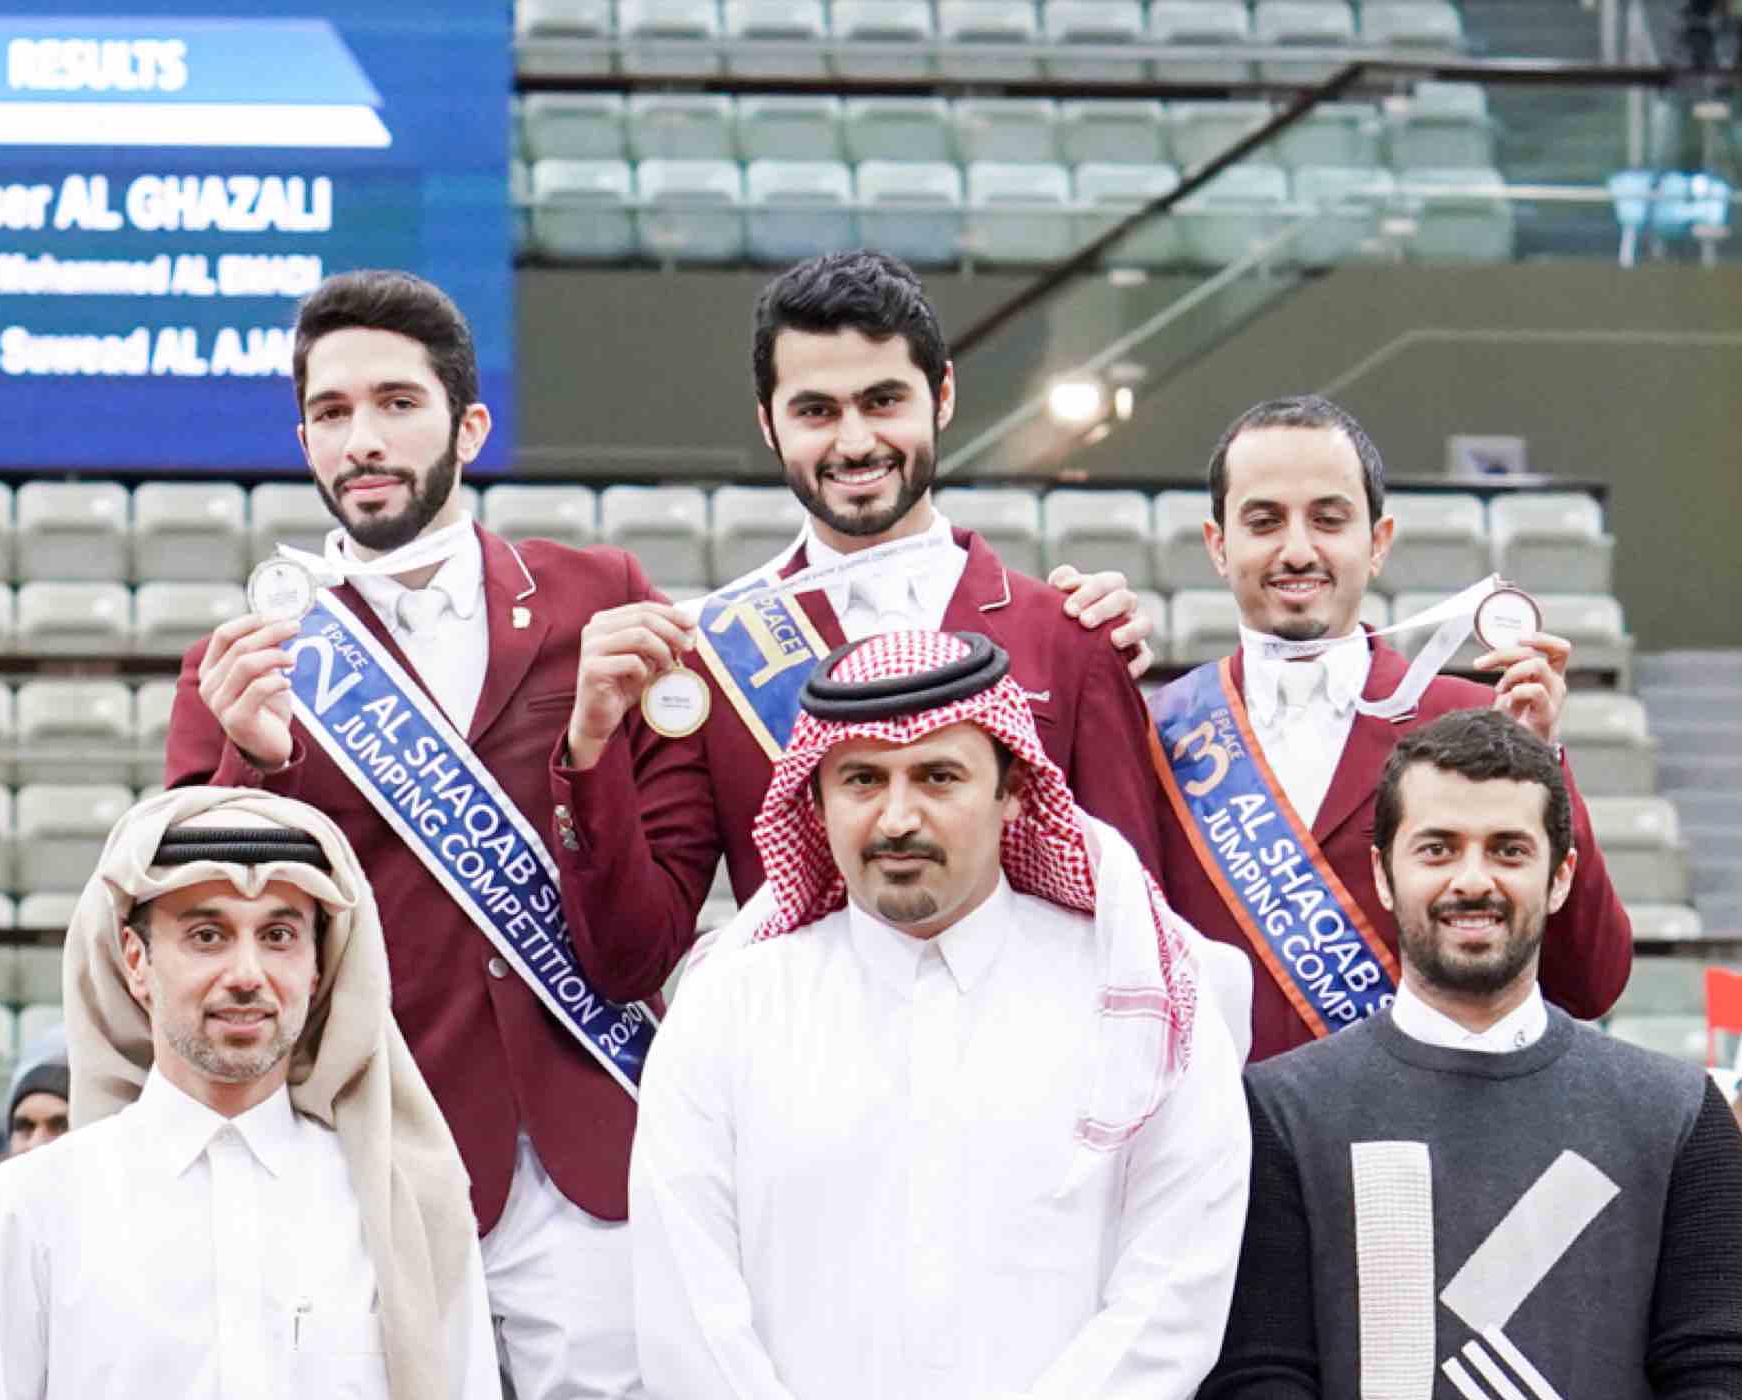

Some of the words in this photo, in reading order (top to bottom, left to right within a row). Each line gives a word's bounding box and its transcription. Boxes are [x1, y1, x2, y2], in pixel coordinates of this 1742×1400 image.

[7, 38, 187, 91] RESULTS
[54, 174, 124, 231] AL
[126, 175, 332, 232] GHAZALI
[171, 254, 217, 295] AL
[151, 326, 209, 376] AL
[361, 694, 412, 744] AL
[403, 735, 538, 886] SHAQAB
[1173, 721, 1229, 796] 3
[333, 715, 449, 838] JUMPING
[440, 833, 605, 1027] COMPETITION
[1203, 808, 1293, 937] JUMPING
[1229, 793, 1276, 842] AL
[1259, 838, 1381, 992] SHAQAB
